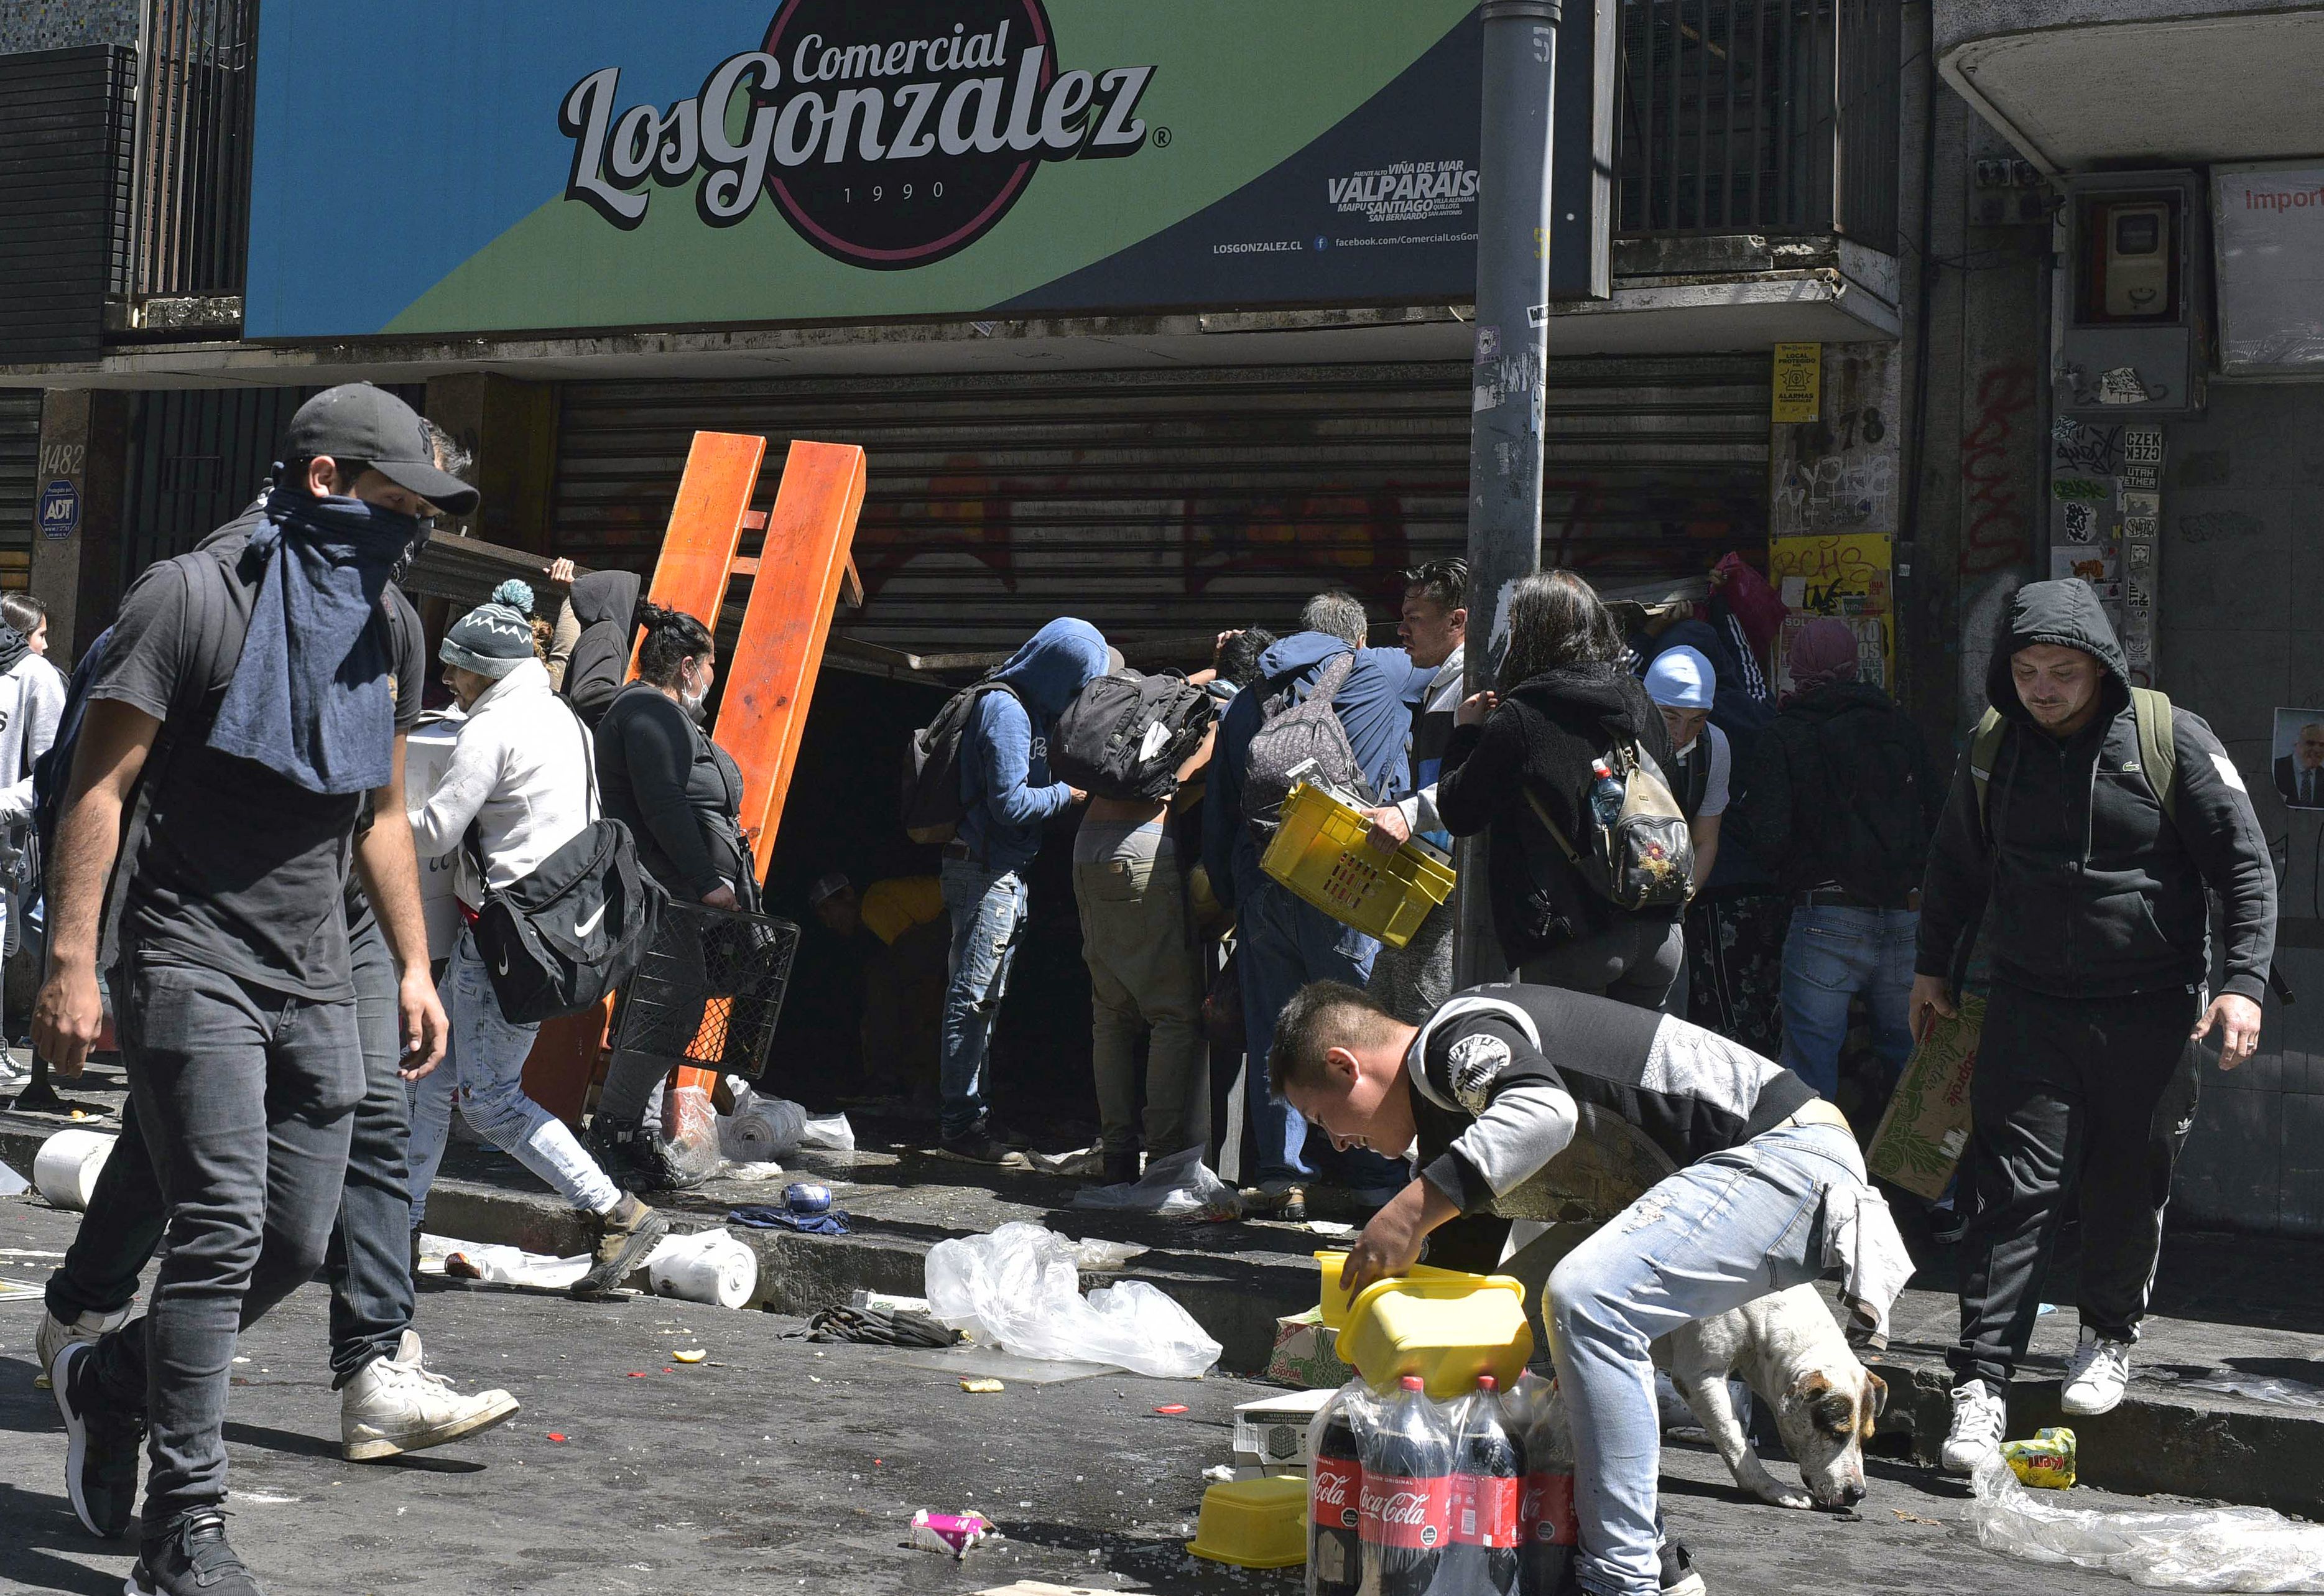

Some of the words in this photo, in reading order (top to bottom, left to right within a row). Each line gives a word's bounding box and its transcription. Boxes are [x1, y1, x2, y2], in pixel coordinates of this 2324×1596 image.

[793, 21, 1006, 84] Comercial
[1388, 161, 1415, 175] VIÑA
[1417, 162, 1435, 173] DEL
[1438, 160, 1464, 172] MAR
[1328, 170, 1479, 204] VALPARAIS
[1338, 202, 1366, 212] MAIPU
[1366, 199, 1433, 215] SANTIAGO
[1369, 214, 1385, 222] SAN
[1386, 211, 1427, 221] BERNARDO
[1213, 241, 1303, 254] LOSGONZALEZ.CL
[2126, 433, 2160, 446] CZEK
[42, 445, 85, 475] 1482
[2127, 467, 2154, 476] UTAH
[45, 499, 73, 520] ADT
[1270, 1363, 1302, 1379] Soprole
[1384, 1477, 1414, 1485] ORIGINAL
